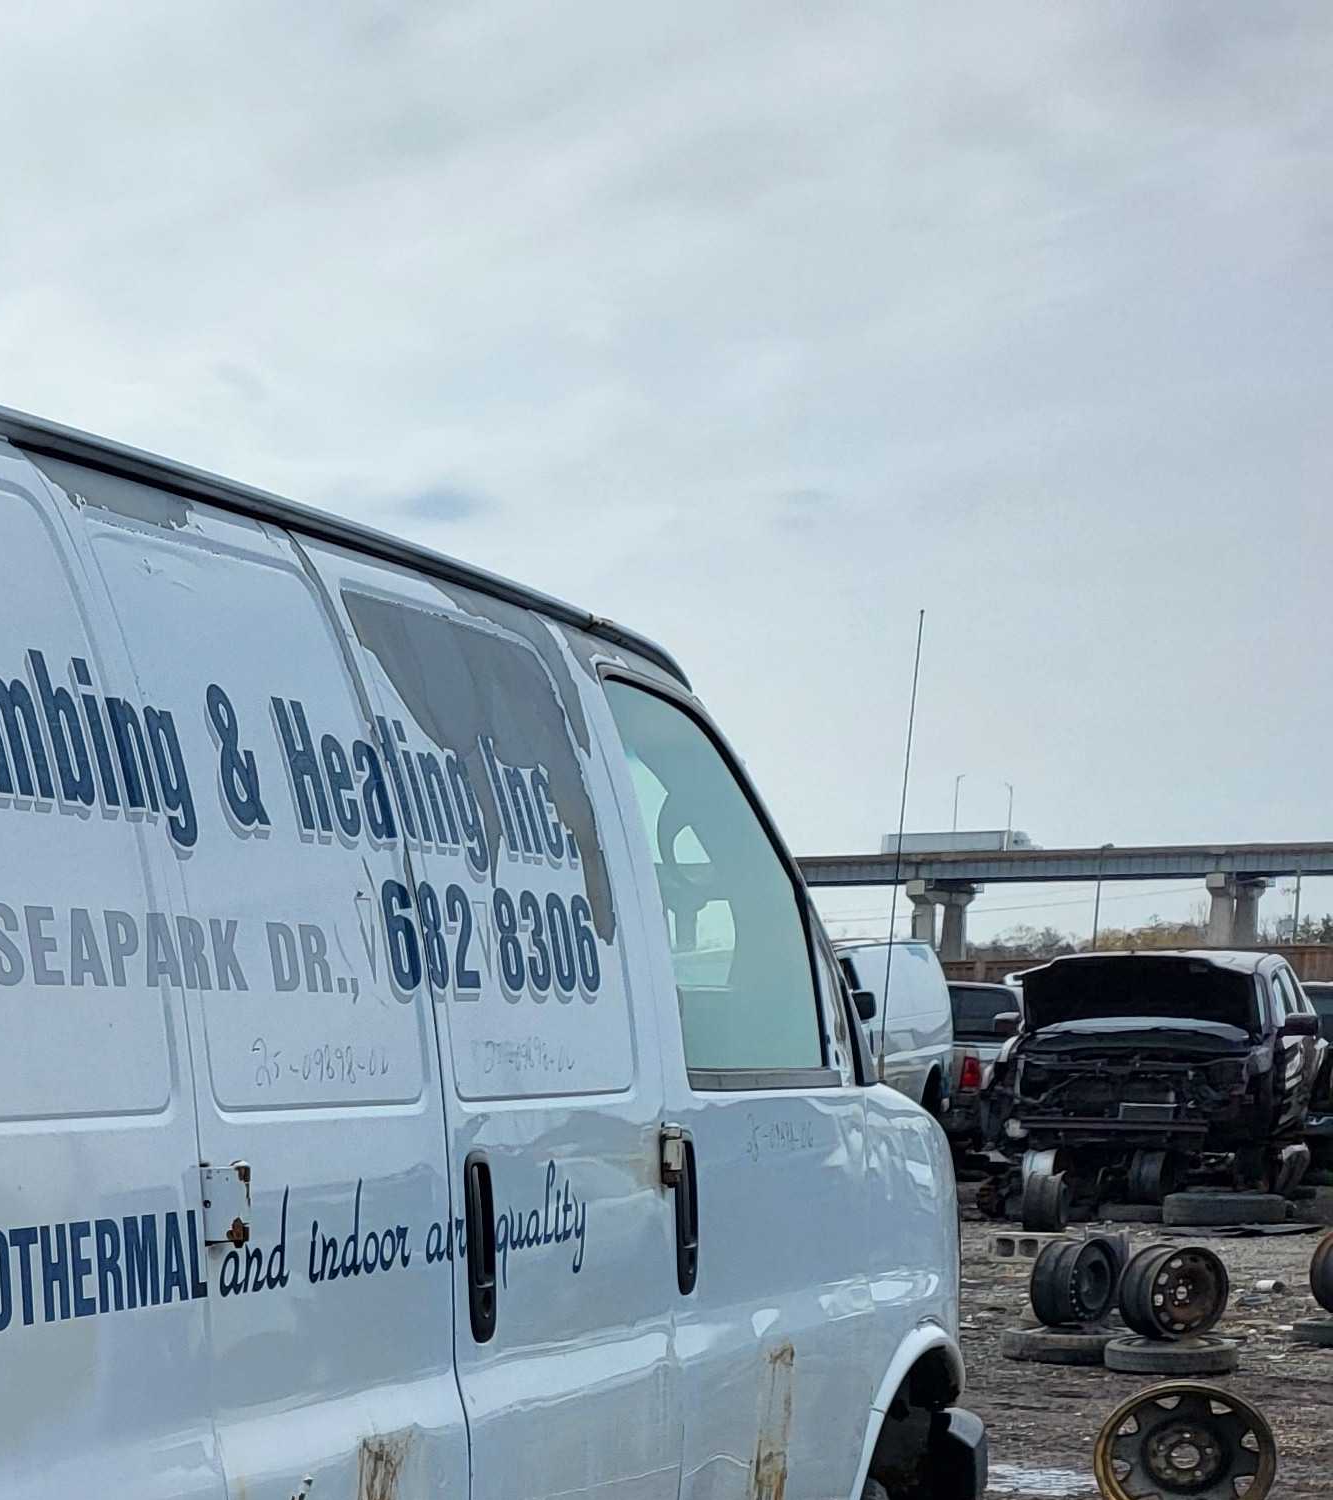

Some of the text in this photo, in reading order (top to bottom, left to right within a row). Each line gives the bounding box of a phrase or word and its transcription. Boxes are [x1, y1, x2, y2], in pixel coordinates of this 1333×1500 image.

[206, 683, 271, 830] &
[270, 696, 489, 873] Heating
[478, 734, 580, 860] Inc.
[380, 878, 481, 991] 682
[492, 886, 601, 993] 8306
[218, 1183, 291, 1298] and
[307, 1176, 412, 1285] indoor
[424, 1212, 470, 1266] air
[493, 1157, 588, 1291] quality
